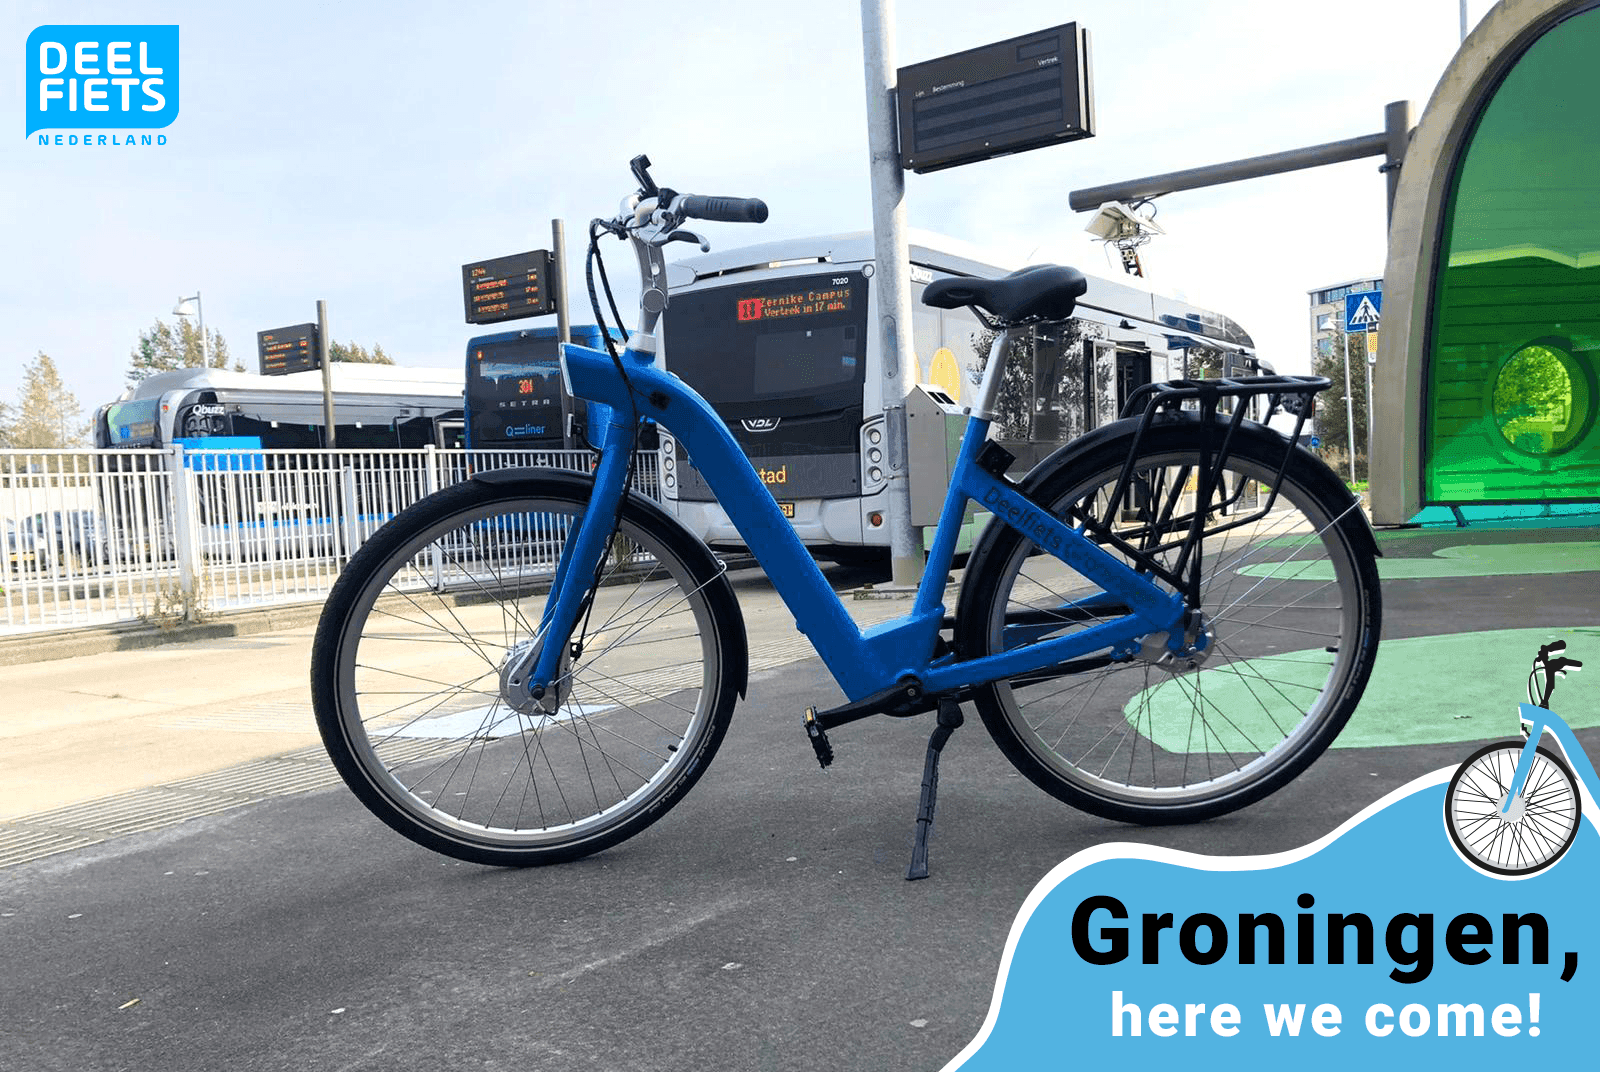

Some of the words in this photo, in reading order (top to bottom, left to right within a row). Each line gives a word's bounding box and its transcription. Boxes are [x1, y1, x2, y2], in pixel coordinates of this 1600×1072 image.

[1037, 56, 1059, 67] Vertrek
[932, 80, 965, 94] Bestemming
[832, 277, 849, 286] 7020
[760, 293, 804, 308] Zernike
[808, 289, 850, 302] Campus
[764, 305, 800, 317] Vertrek
[803, 304, 813, 314] in
[815, 301, 825, 312] 17
[827, 300, 846, 311] min.
[192, 403, 225, 416] Qbuzz
[747, 418, 774, 428] VDL
[759, 465, 787, 484] tad
[983, 486, 1063, 549] Deelfiets
